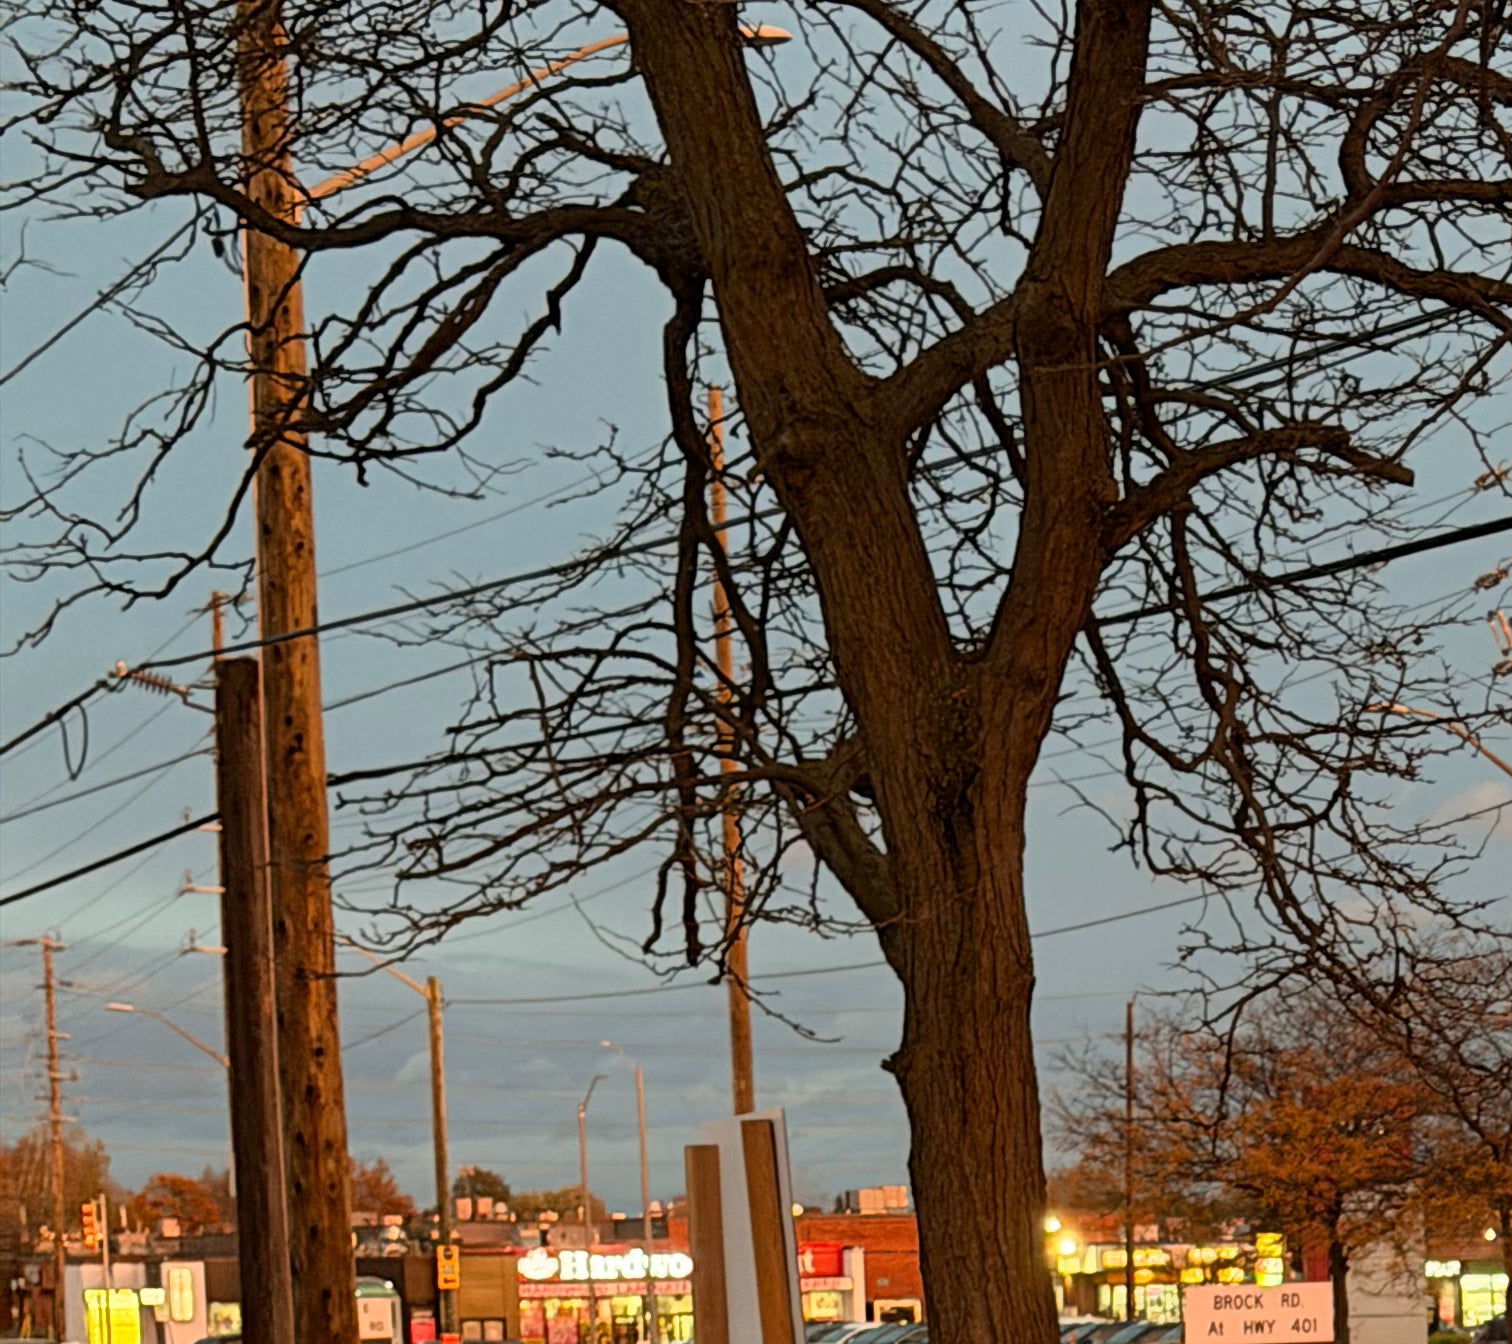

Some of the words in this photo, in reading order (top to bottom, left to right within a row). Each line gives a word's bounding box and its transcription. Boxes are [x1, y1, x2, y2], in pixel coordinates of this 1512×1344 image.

[1213, 1294, 1264, 1311] BROCK
[1243, 1319, 1276, 1336] HWY
[1291, 1318, 1318, 1334] 401
